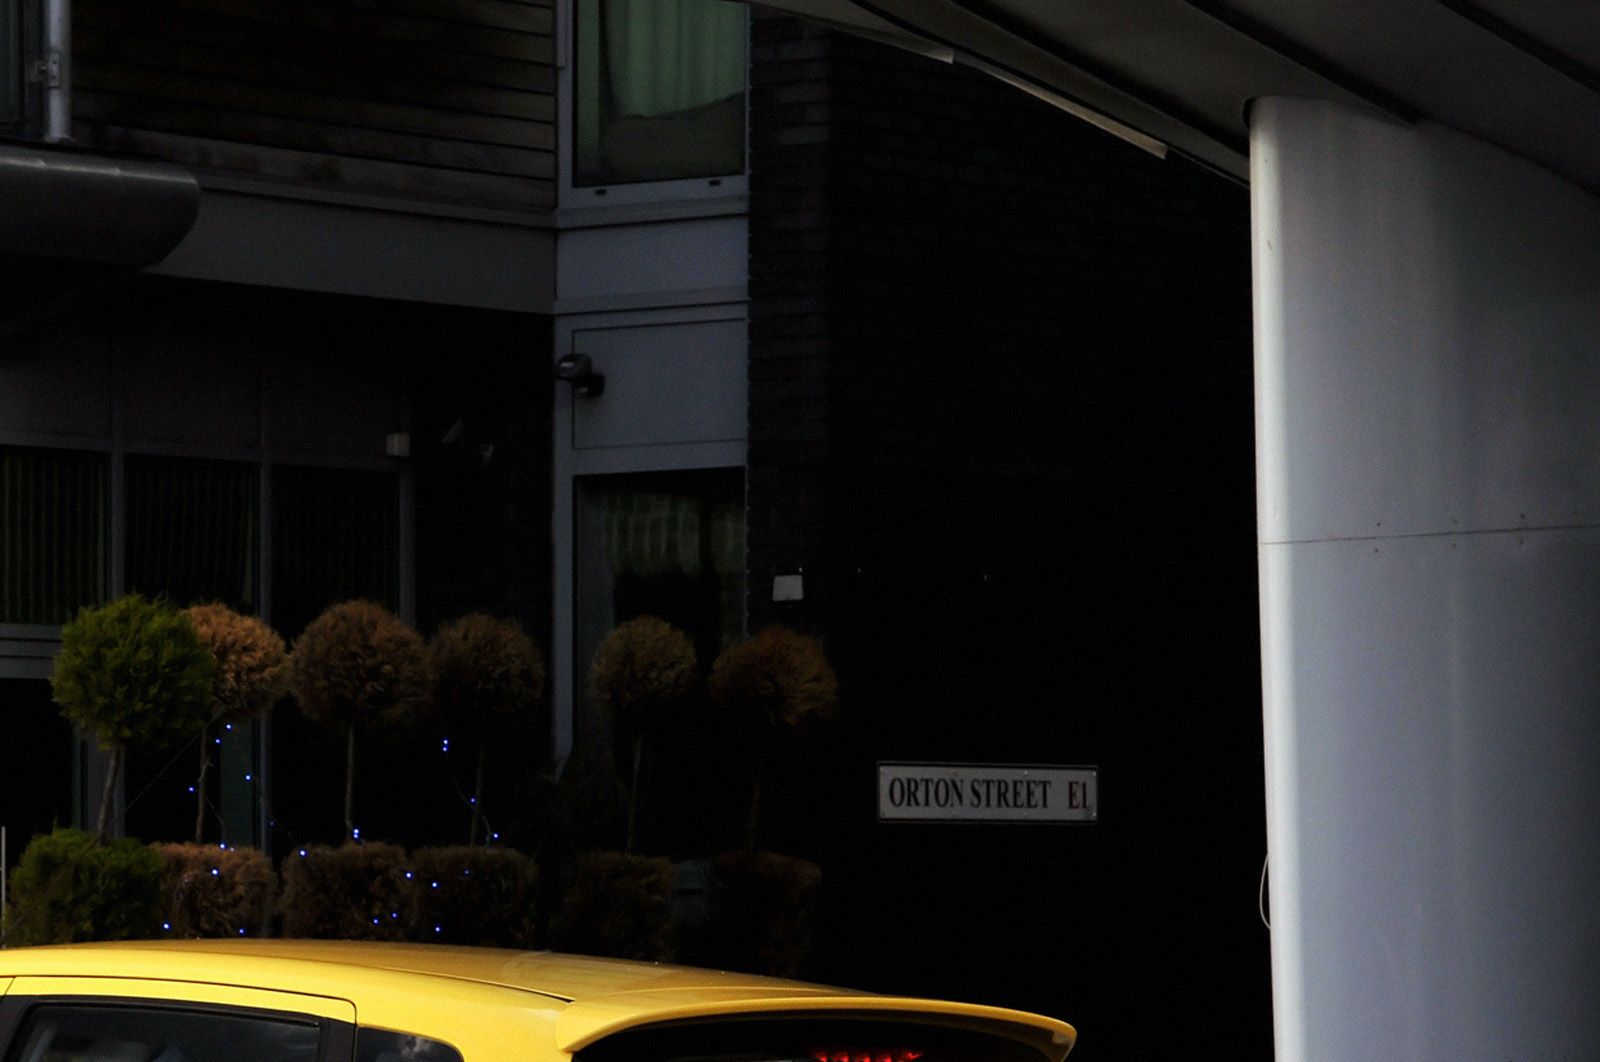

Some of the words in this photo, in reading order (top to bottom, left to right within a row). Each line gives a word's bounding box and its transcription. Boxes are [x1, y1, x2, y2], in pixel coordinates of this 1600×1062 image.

[889, 777, 964, 808] ORTON
[970, 778, 1051, 810] STREET
[1068, 780, 1088, 810] E1
